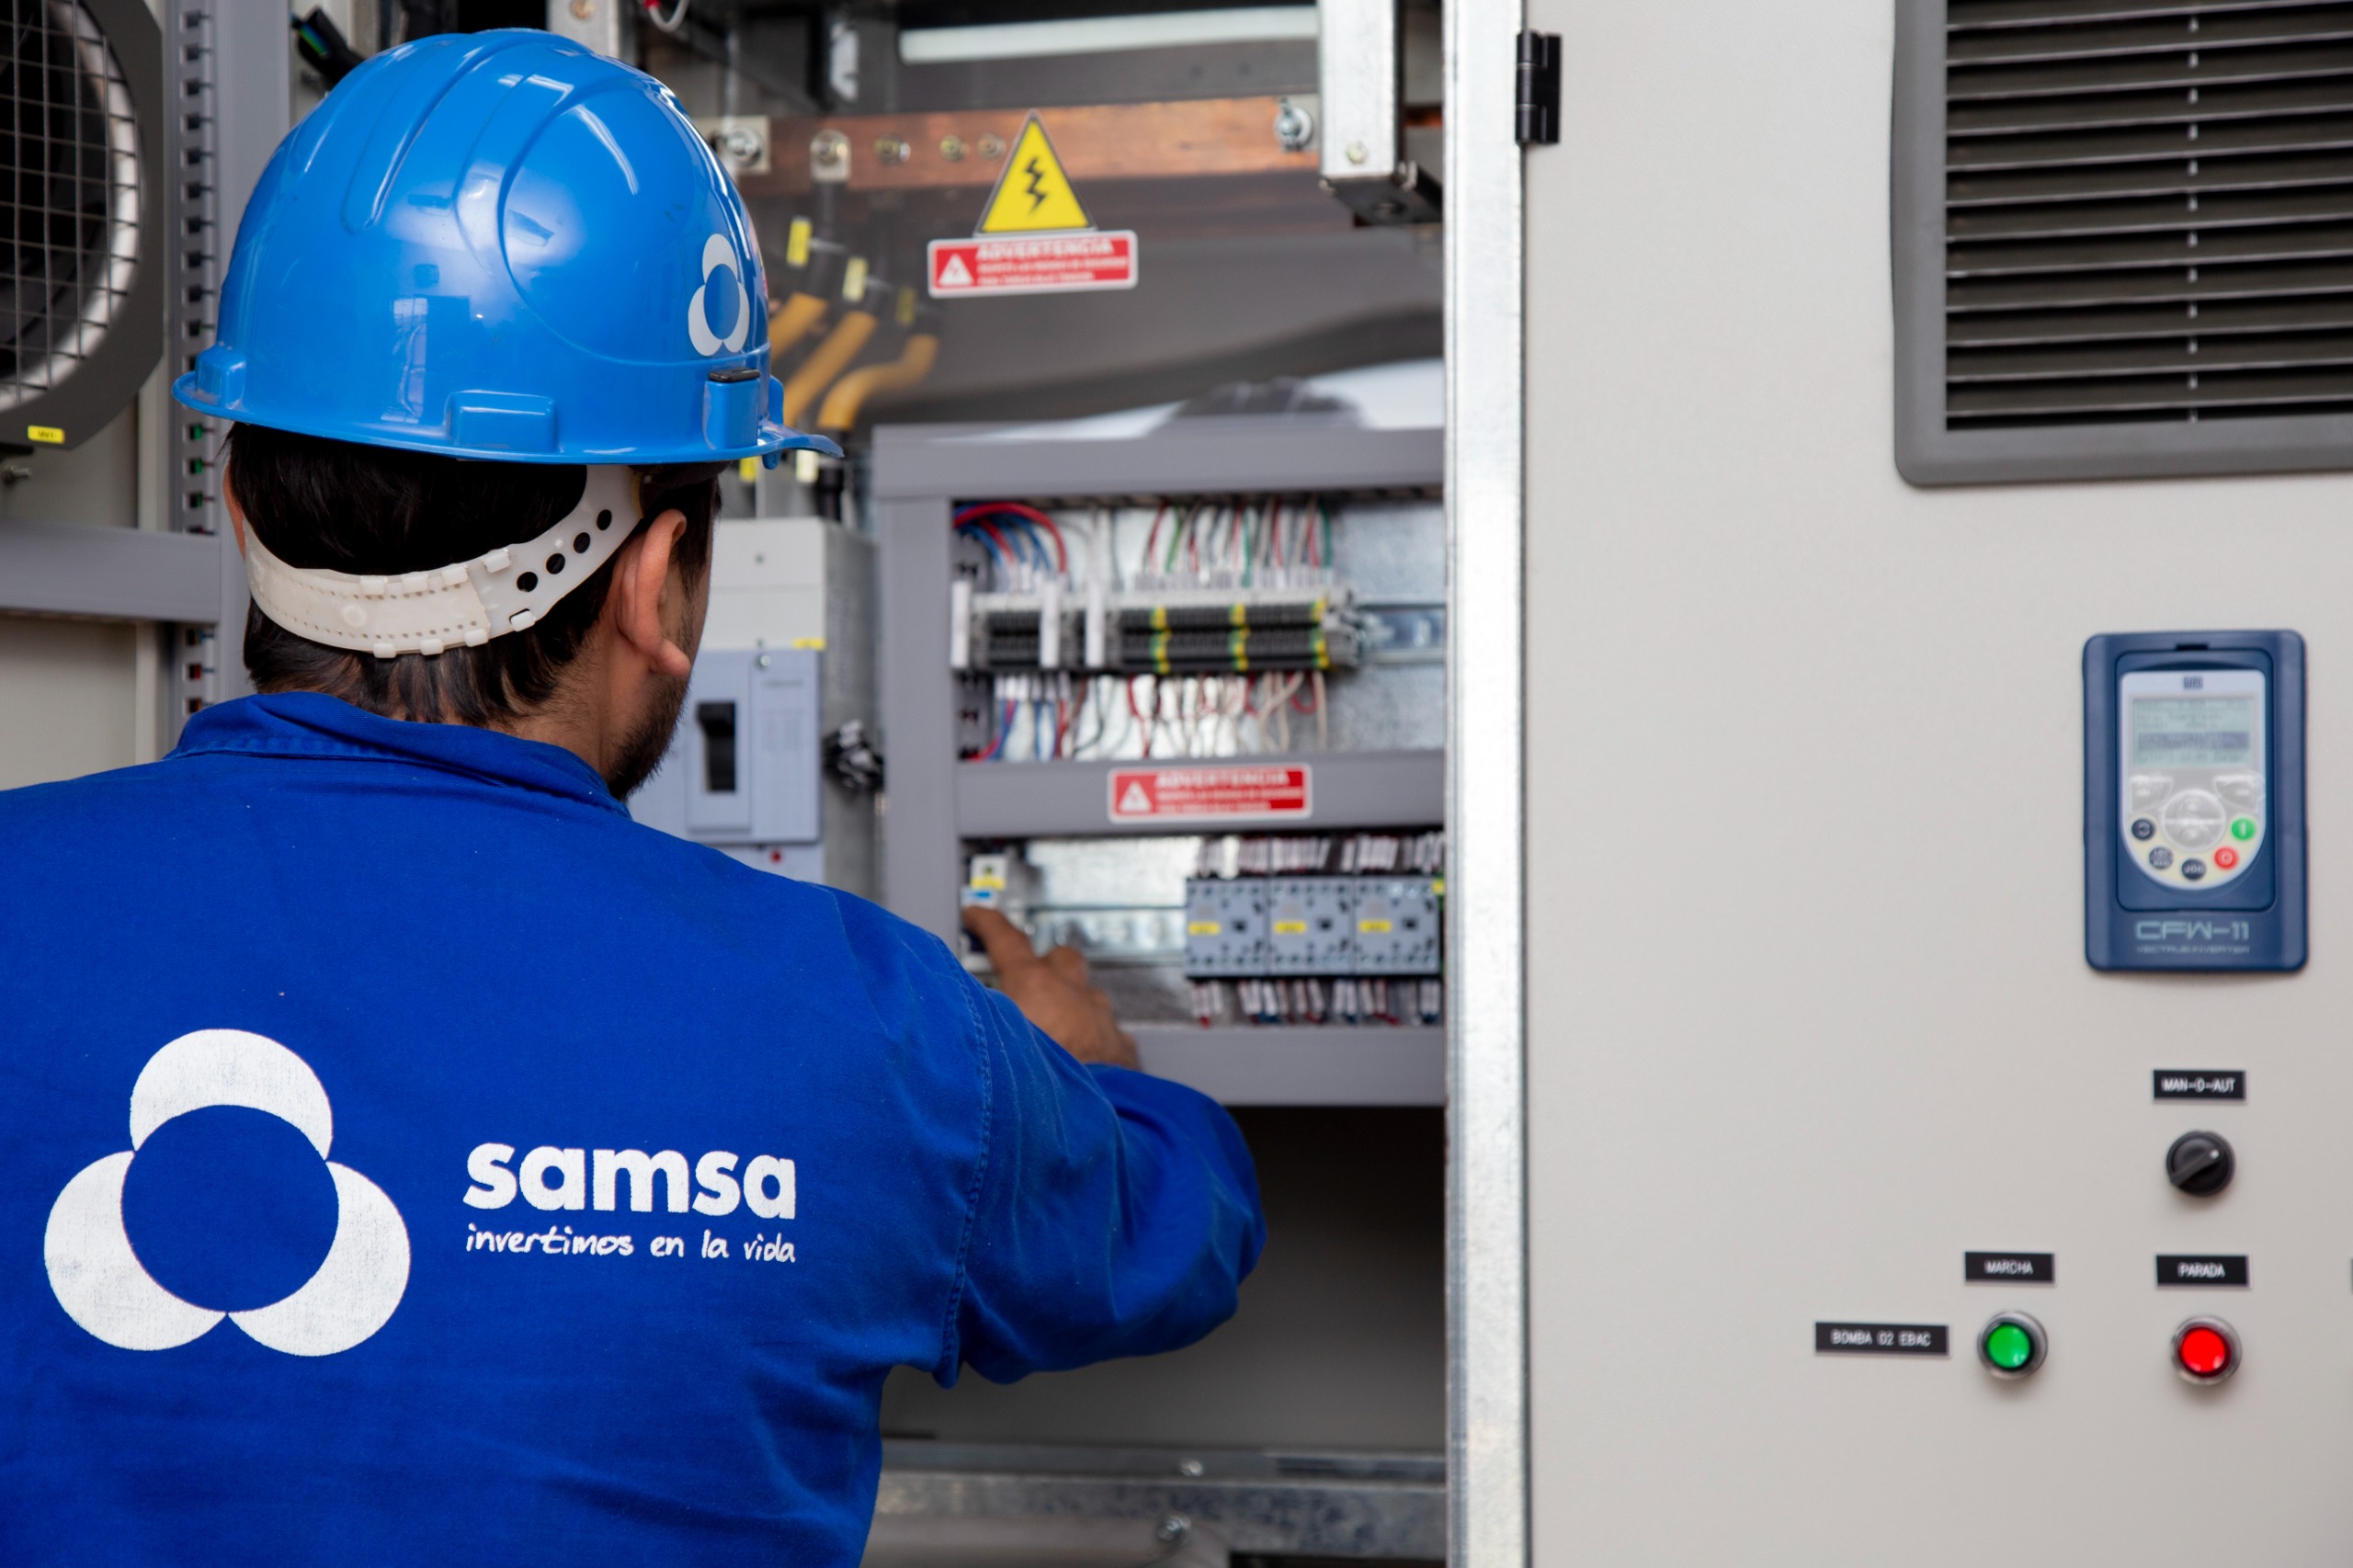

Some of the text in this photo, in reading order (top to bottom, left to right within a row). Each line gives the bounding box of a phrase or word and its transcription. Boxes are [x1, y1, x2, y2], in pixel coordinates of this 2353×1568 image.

[976, 237, 1114, 260] ADVERTENCIA
[2136, 920, 2250, 941] CFW-11
[463, 1142, 795, 1220] samsa
[466, 1223, 796, 1263] invertimos en la vida
[1984, 1259, 2033, 1275] MARCHA
[2177, 1262, 2225, 1278] PARADA
[1830, 1328, 1872, 1345] BOMBA
[1898, 1331, 1932, 1346] EBAC
